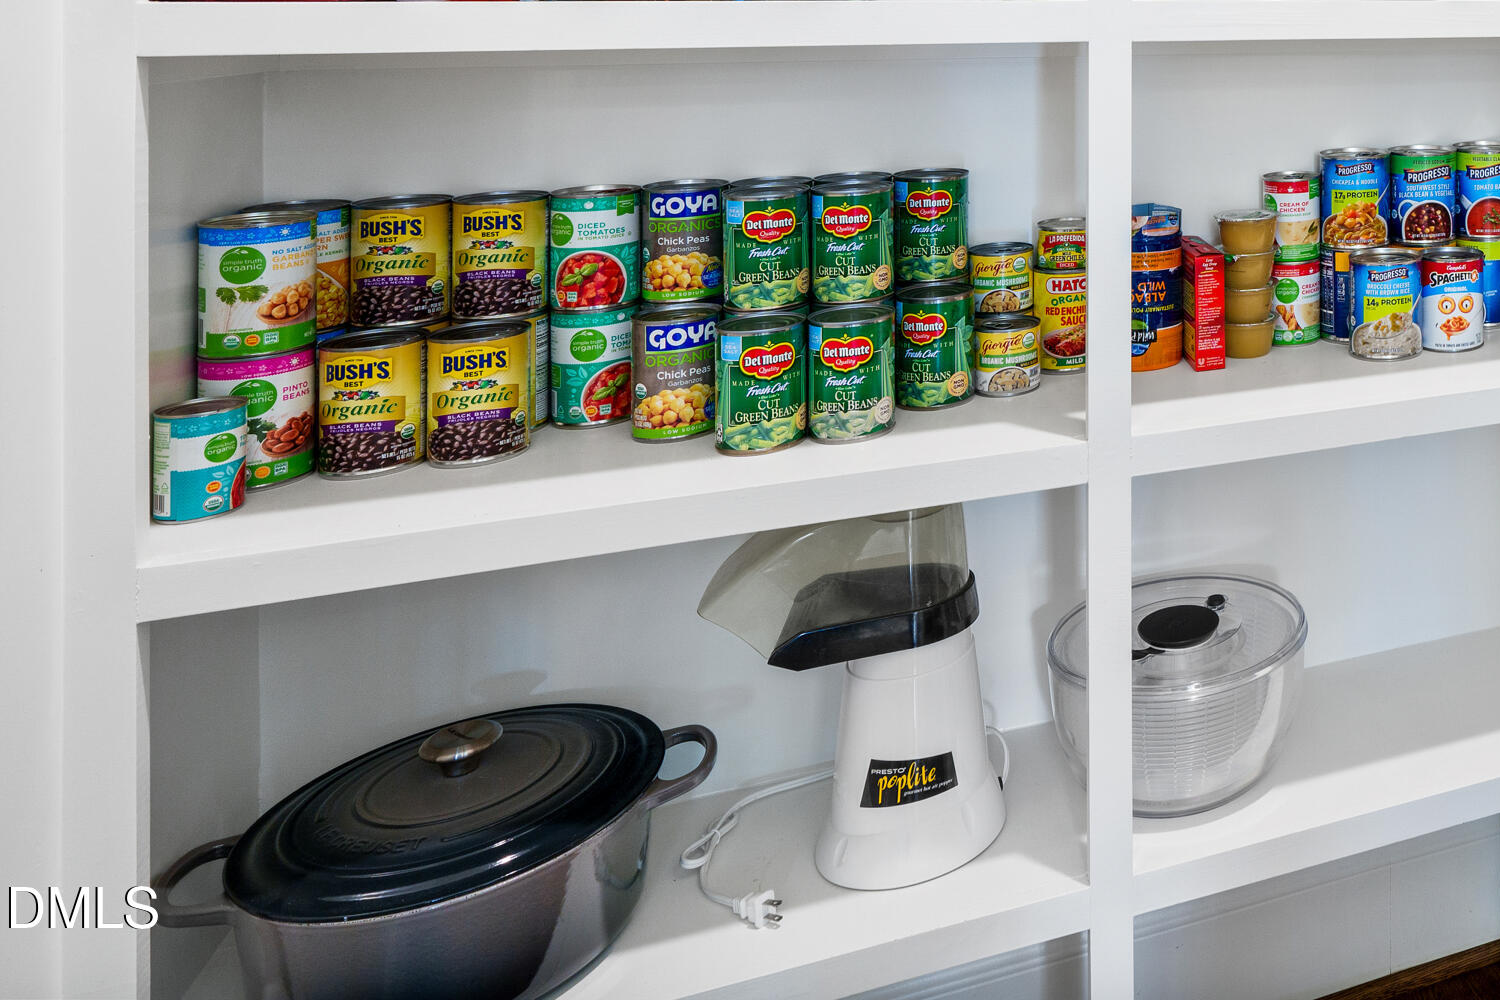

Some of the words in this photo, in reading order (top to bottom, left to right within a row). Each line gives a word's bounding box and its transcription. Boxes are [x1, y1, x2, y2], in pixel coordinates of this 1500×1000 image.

[1338, 164, 1372, 175] PROGRESSO
[1407, 167, 1450, 183] PROGRESSO
[1347, 191, 1378, 199] PROTEIN
[652, 193, 717, 217] GOYA
[909, 200, 922, 208] Del
[923, 197, 950, 207] Monte
[463, 213, 522, 234] BUSH'S
[649, 217, 721, 233] ORGANICS
[746, 220, 761, 230] Del
[763, 217, 792, 228] Monte
[824, 216, 838, 225] Del
[840, 213, 868, 224] Monte
[360, 216, 422, 239] BUSH'S
[577, 222, 606, 230] DICED
[577, 226, 625, 236] TOMATOES
[657, 235, 684, 246] Chick
[687, 234, 710, 244] Peas
[919, 237, 938, 246] CUT
[1057, 234, 1085, 242] PREFERIDA
[286, 246, 301, 254] SALT
[666, 245, 700, 253] Garbanzos
[930, 244, 956, 255] BEANS
[458, 247, 529, 268] Organic
[835, 256, 855, 266] CUT
[222, 264, 263, 273] organic
[272, 260, 305, 271] BEANS
[356, 255, 430, 275] Organic
[759, 261, 780, 272] CUT
[847, 264, 876, 274] BEANS
[975, 257, 1013, 277] Giorgio
[772, 267, 800, 279] BEANS
[1371, 269, 1407, 282] PROGRESSO
[1381, 297, 1411, 306] PROTEIN
[903, 322, 916, 331] Del
[918, 320, 944, 331] Monte
[649, 321, 717, 350] GOYA
[572, 343, 604, 352] organic
[982, 334, 1022, 354] Giorgio
[823, 347, 838, 357] Del
[840, 344, 869, 356] Monte
[442, 349, 508, 374] BUSH'S
[744, 355, 760, 366] Del
[761, 351, 792, 363] Monte
[326, 361, 391, 383] BUSH'S
[657, 368, 686, 380] Chick
[689, 365, 711, 376] Peas
[912, 363, 930, 372] CUT
[463, 370, 484, 378] BEST
[922, 370, 951, 381] BEANS
[343, 380, 364, 388] BEST
[668, 377, 703, 387] Garbanzos
[825, 376, 847, 387] Fresh
[282, 382, 308, 394] PINTO
[746, 383, 771, 397] Fresh
[282, 388, 310, 401] BEANS
[436, 387, 513, 410] Organic
[835, 390, 856, 401] CUT
[322, 398, 399, 420] Organic
[758, 398, 779, 410] CUT
[771, 403, 799, 417] BEANS
[817, 401, 845, 411] GREEN
[848, 397, 878, 409] BEANS
[871, 767, 906, 775] PRESTO
[877, 761, 937, 805] poplite
